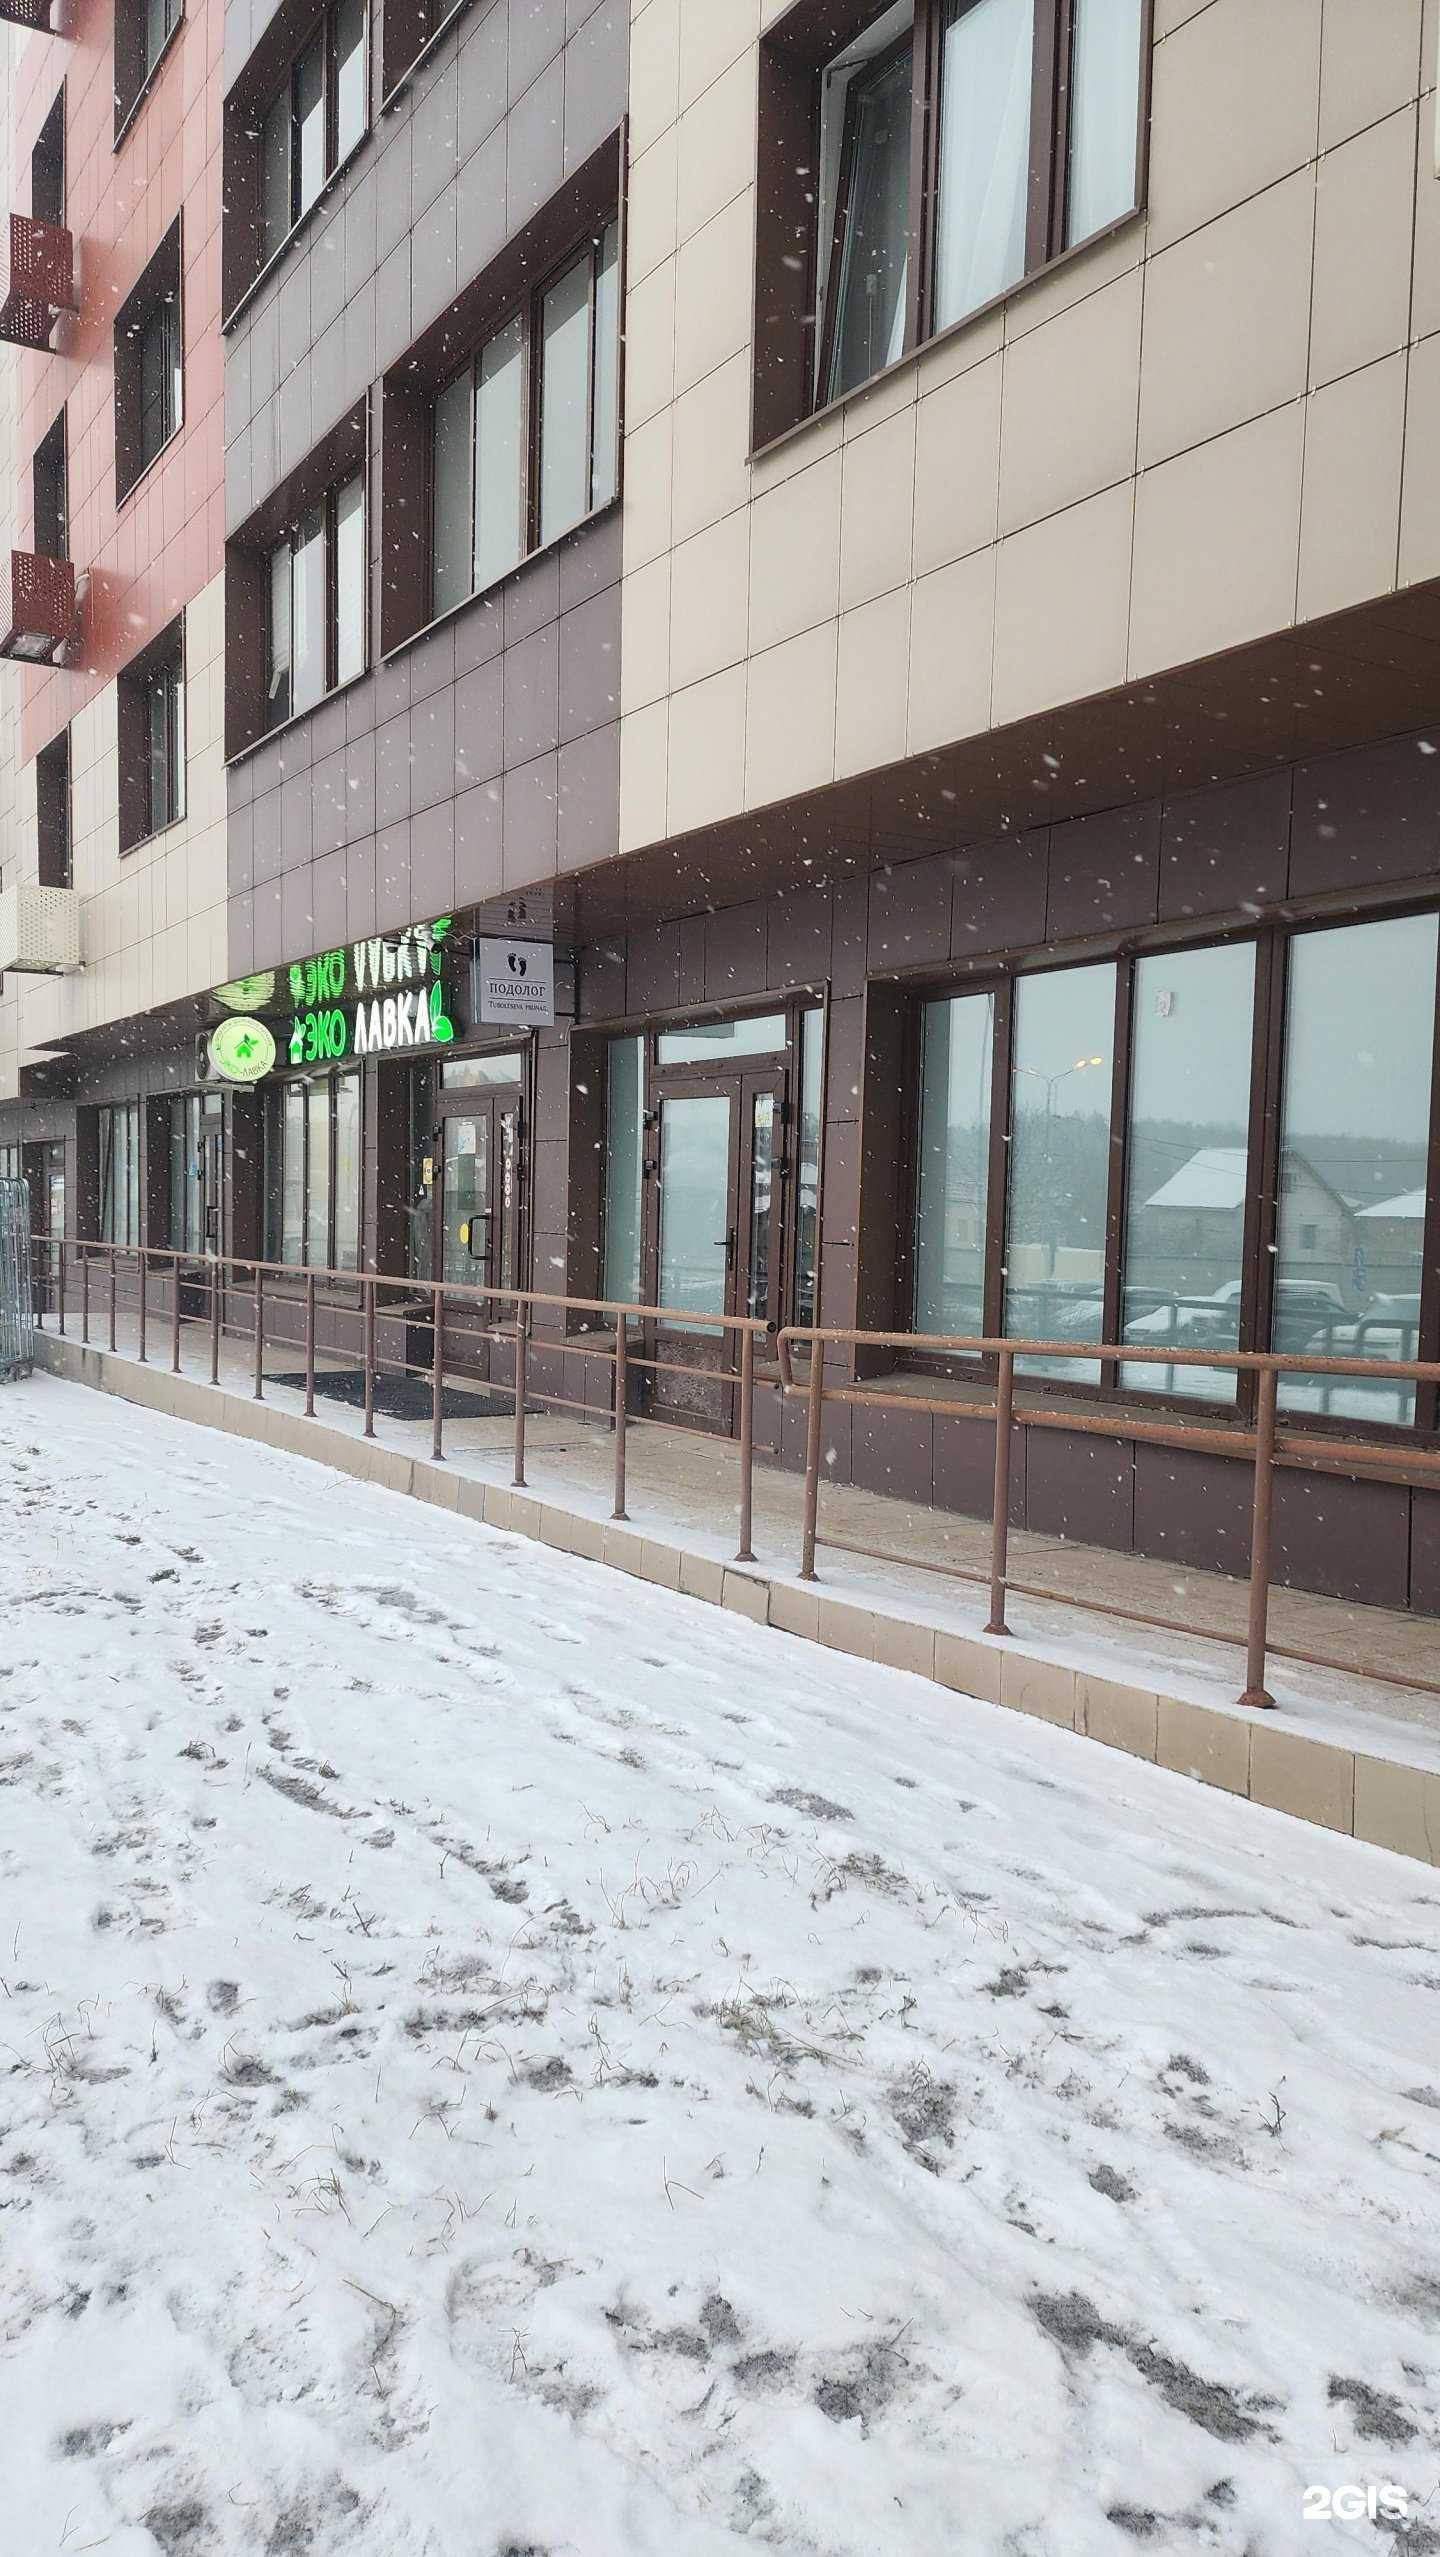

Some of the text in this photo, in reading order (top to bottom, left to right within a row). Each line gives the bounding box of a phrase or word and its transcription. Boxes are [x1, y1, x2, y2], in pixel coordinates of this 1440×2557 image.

[490, 983, 546, 997] ПОДОЛОГ
[305, 1008, 346, 1061] ЭКО
[354, 986, 431, 1055] ЛАВКА
